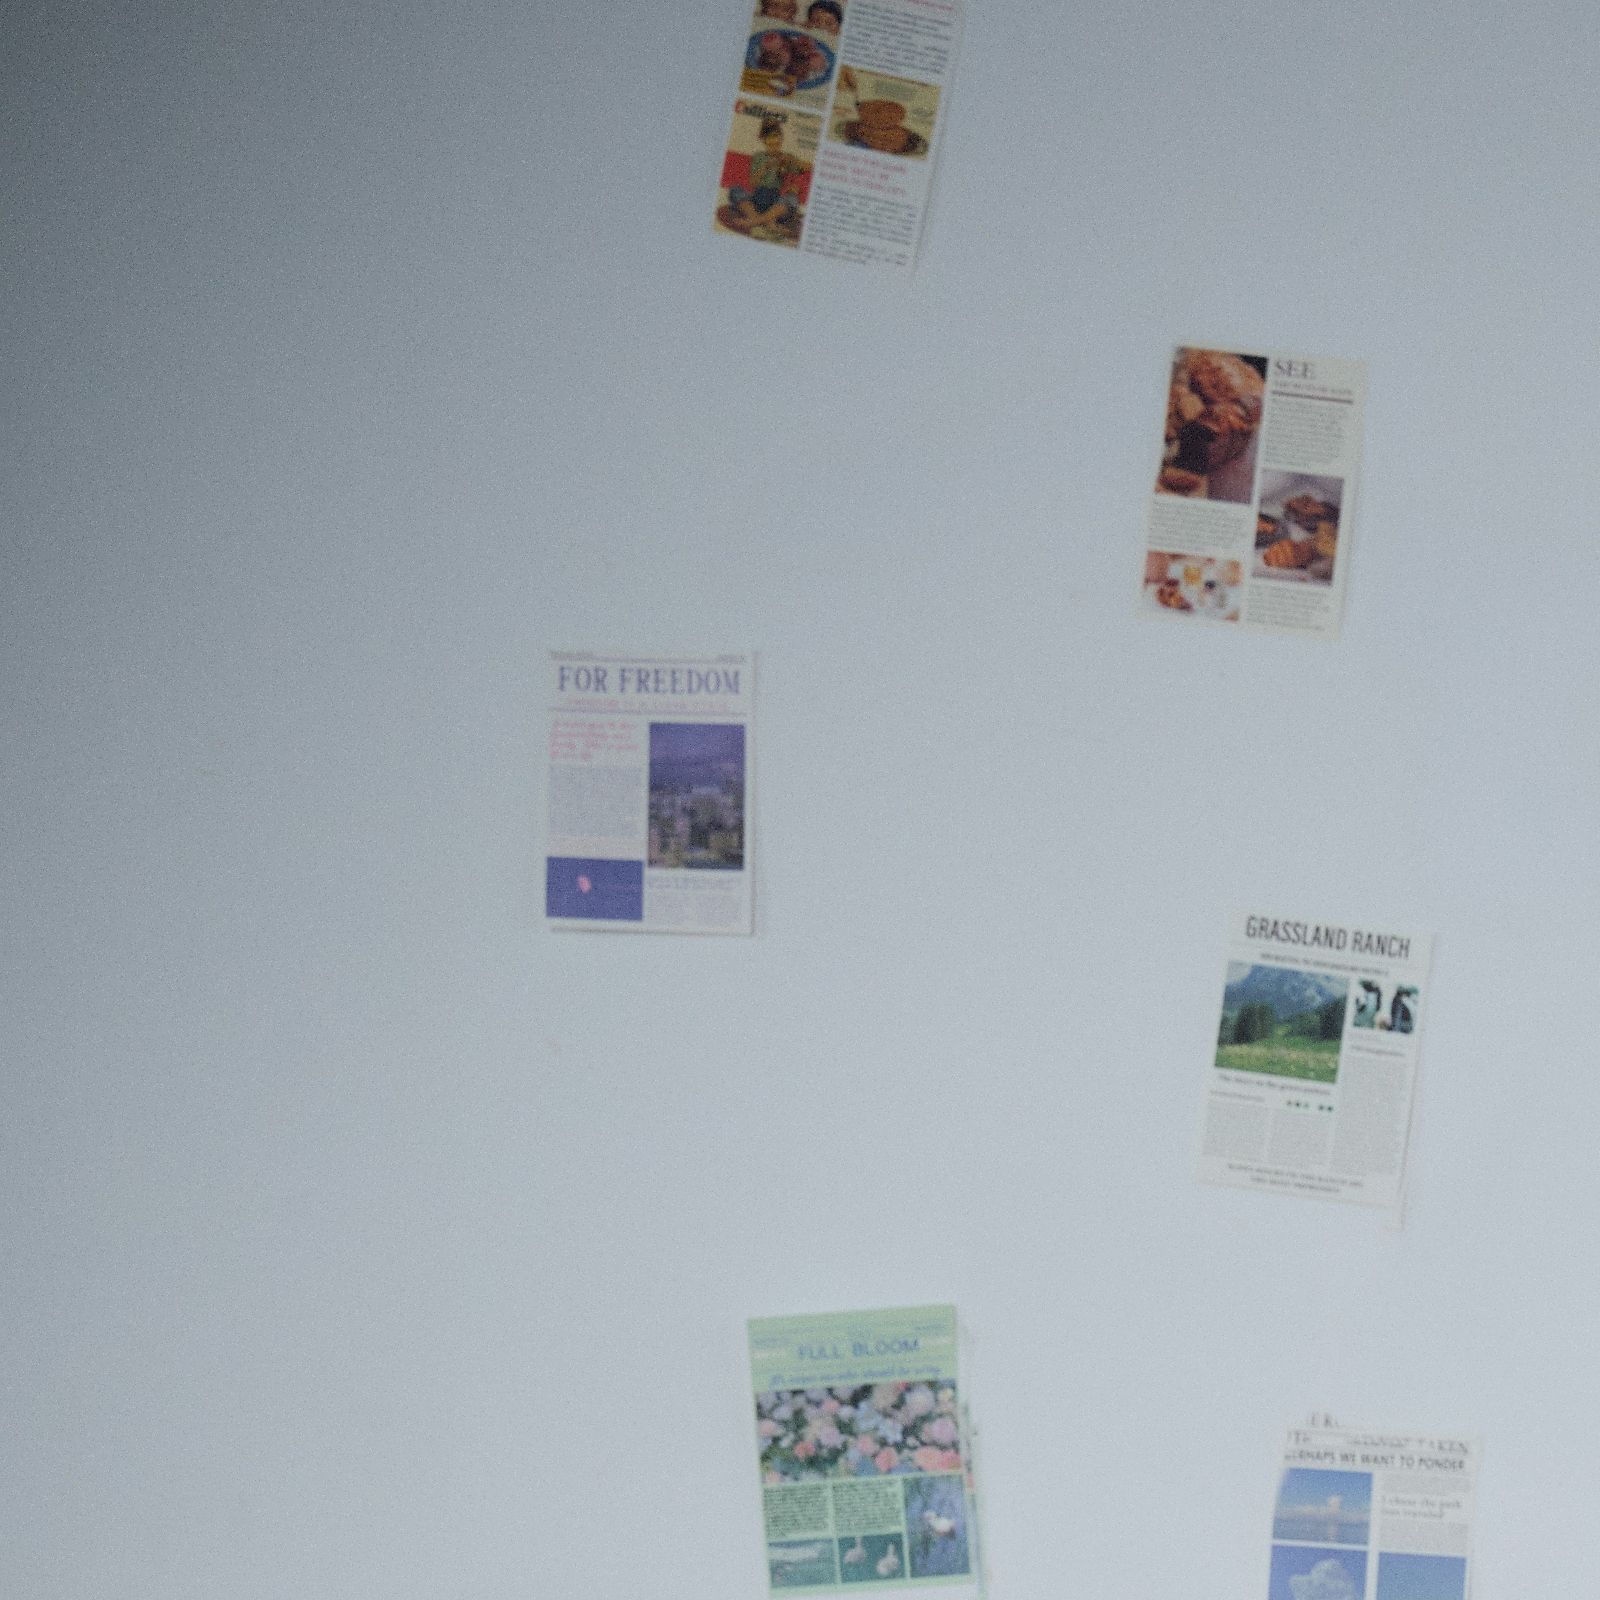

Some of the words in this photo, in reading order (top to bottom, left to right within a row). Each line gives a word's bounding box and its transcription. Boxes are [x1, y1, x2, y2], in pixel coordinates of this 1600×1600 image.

[558, 665, 608, 693] FOR
[618, 667, 742, 695] FREEDOM
[1245, 913, 1347, 951] GRASSLAND
[1352, 932, 1411, 960] RANCH
[797, 1343, 842, 1360] FULL
[851, 1338, 920, 1358] BLOOM
[1361, 1453, 1396, 1468] WANT
[1399, 1455, 1415, 1470] TO
